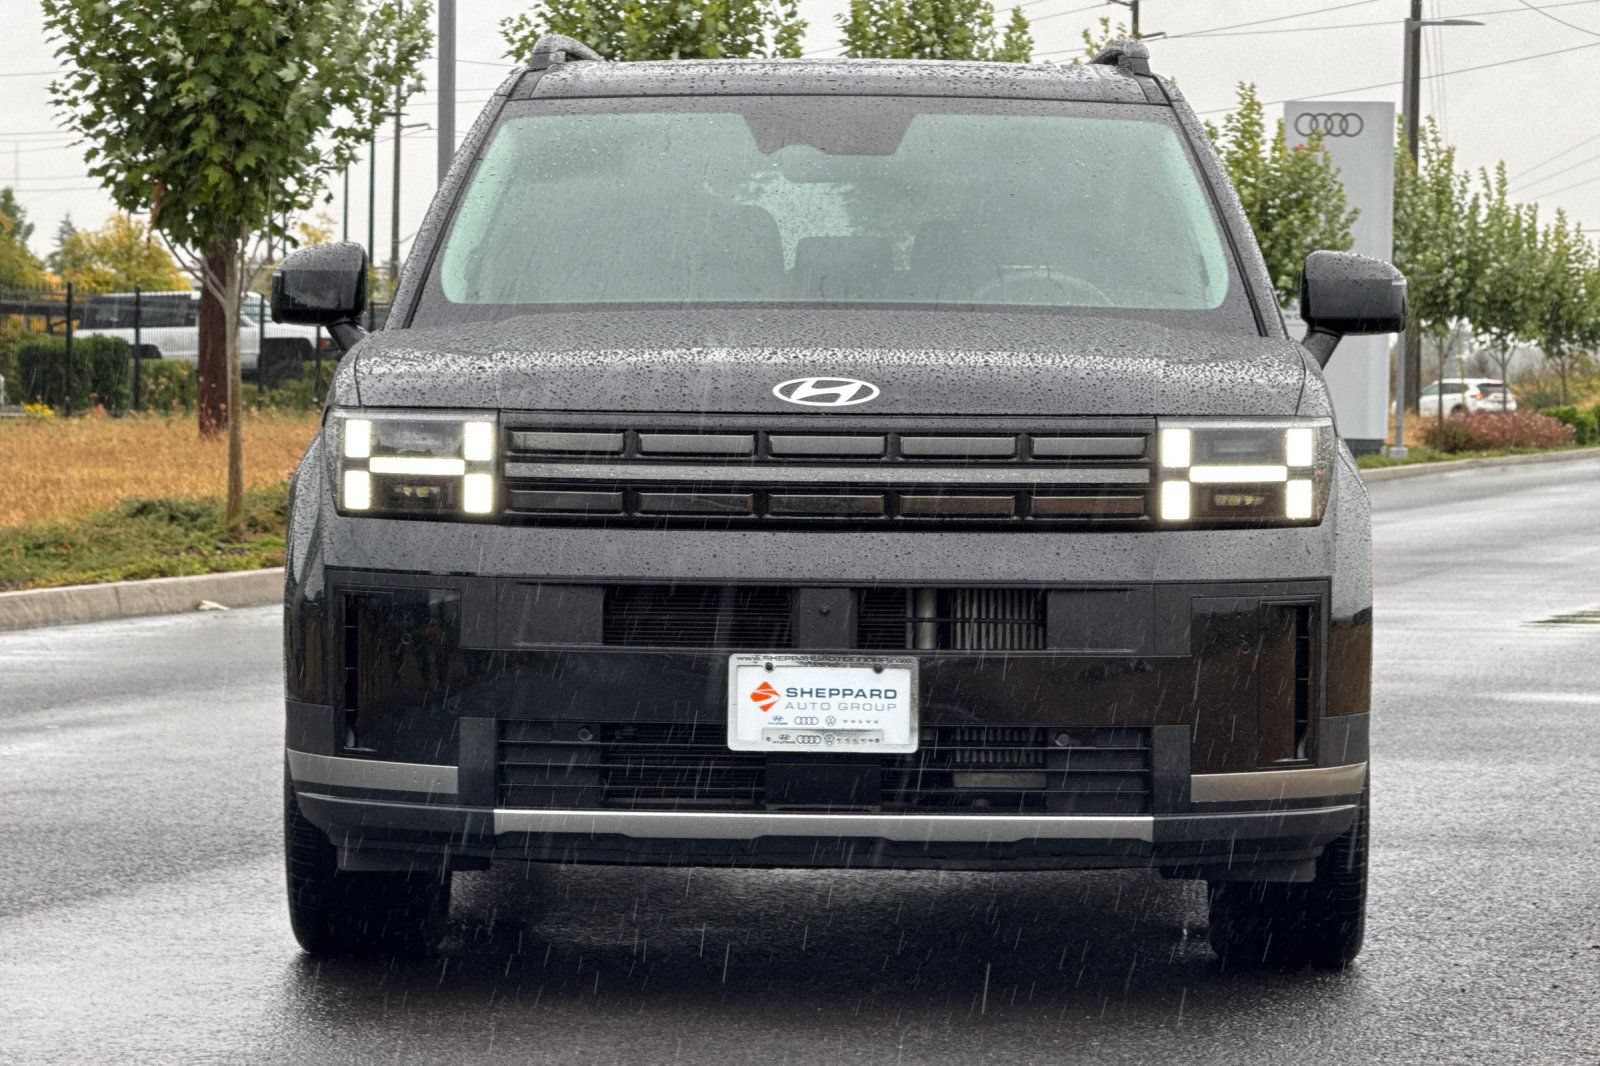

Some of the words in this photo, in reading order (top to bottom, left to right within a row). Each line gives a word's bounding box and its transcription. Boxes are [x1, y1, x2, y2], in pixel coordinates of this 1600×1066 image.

[785, 687, 897, 699] SHEPPARD
[785, 702, 831, 711] AUTO
[838, 702, 897, 712] GROUP
